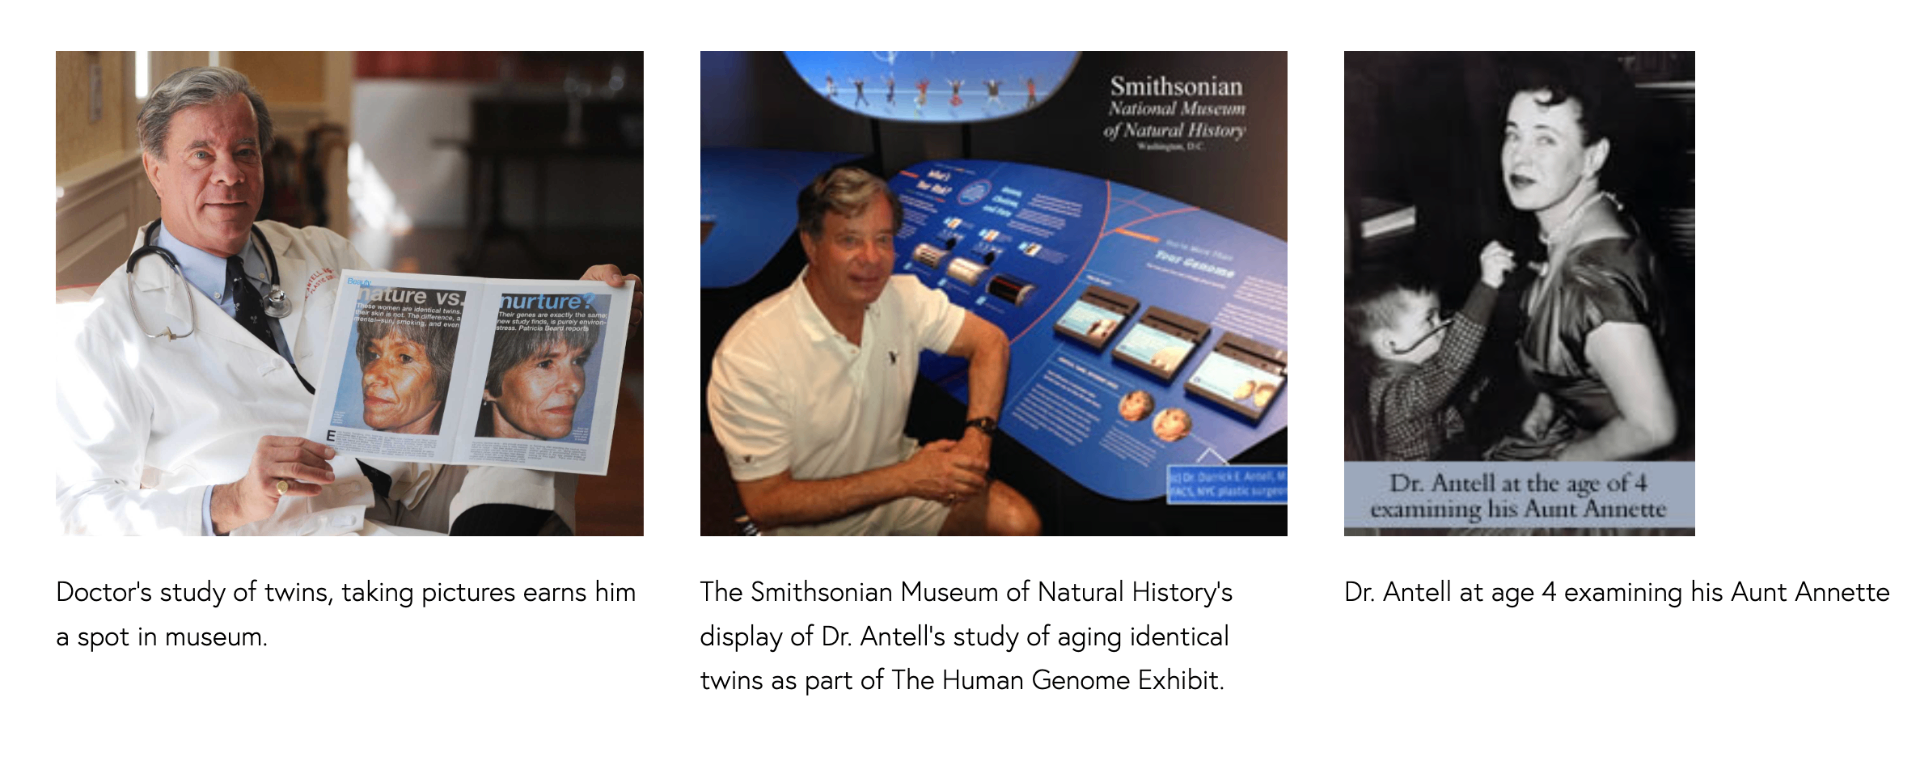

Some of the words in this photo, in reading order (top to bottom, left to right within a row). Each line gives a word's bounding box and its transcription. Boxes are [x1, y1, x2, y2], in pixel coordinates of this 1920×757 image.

[1155, 250, 1183, 264] Your
[1183, 258, 1235, 278] Genome
[358, 286, 427, 304] nature
[436, 292, 464, 306] vs.
[500, 292, 596, 310] nurture?
[414, 306, 441, 314] identical
[421, 314, 455, 322] difference,
[512, 318, 530, 326] study
[531, 318, 549, 326] finds,
[557, 319, 578, 327] purely
[396, 319, 427, 327] smoking,
